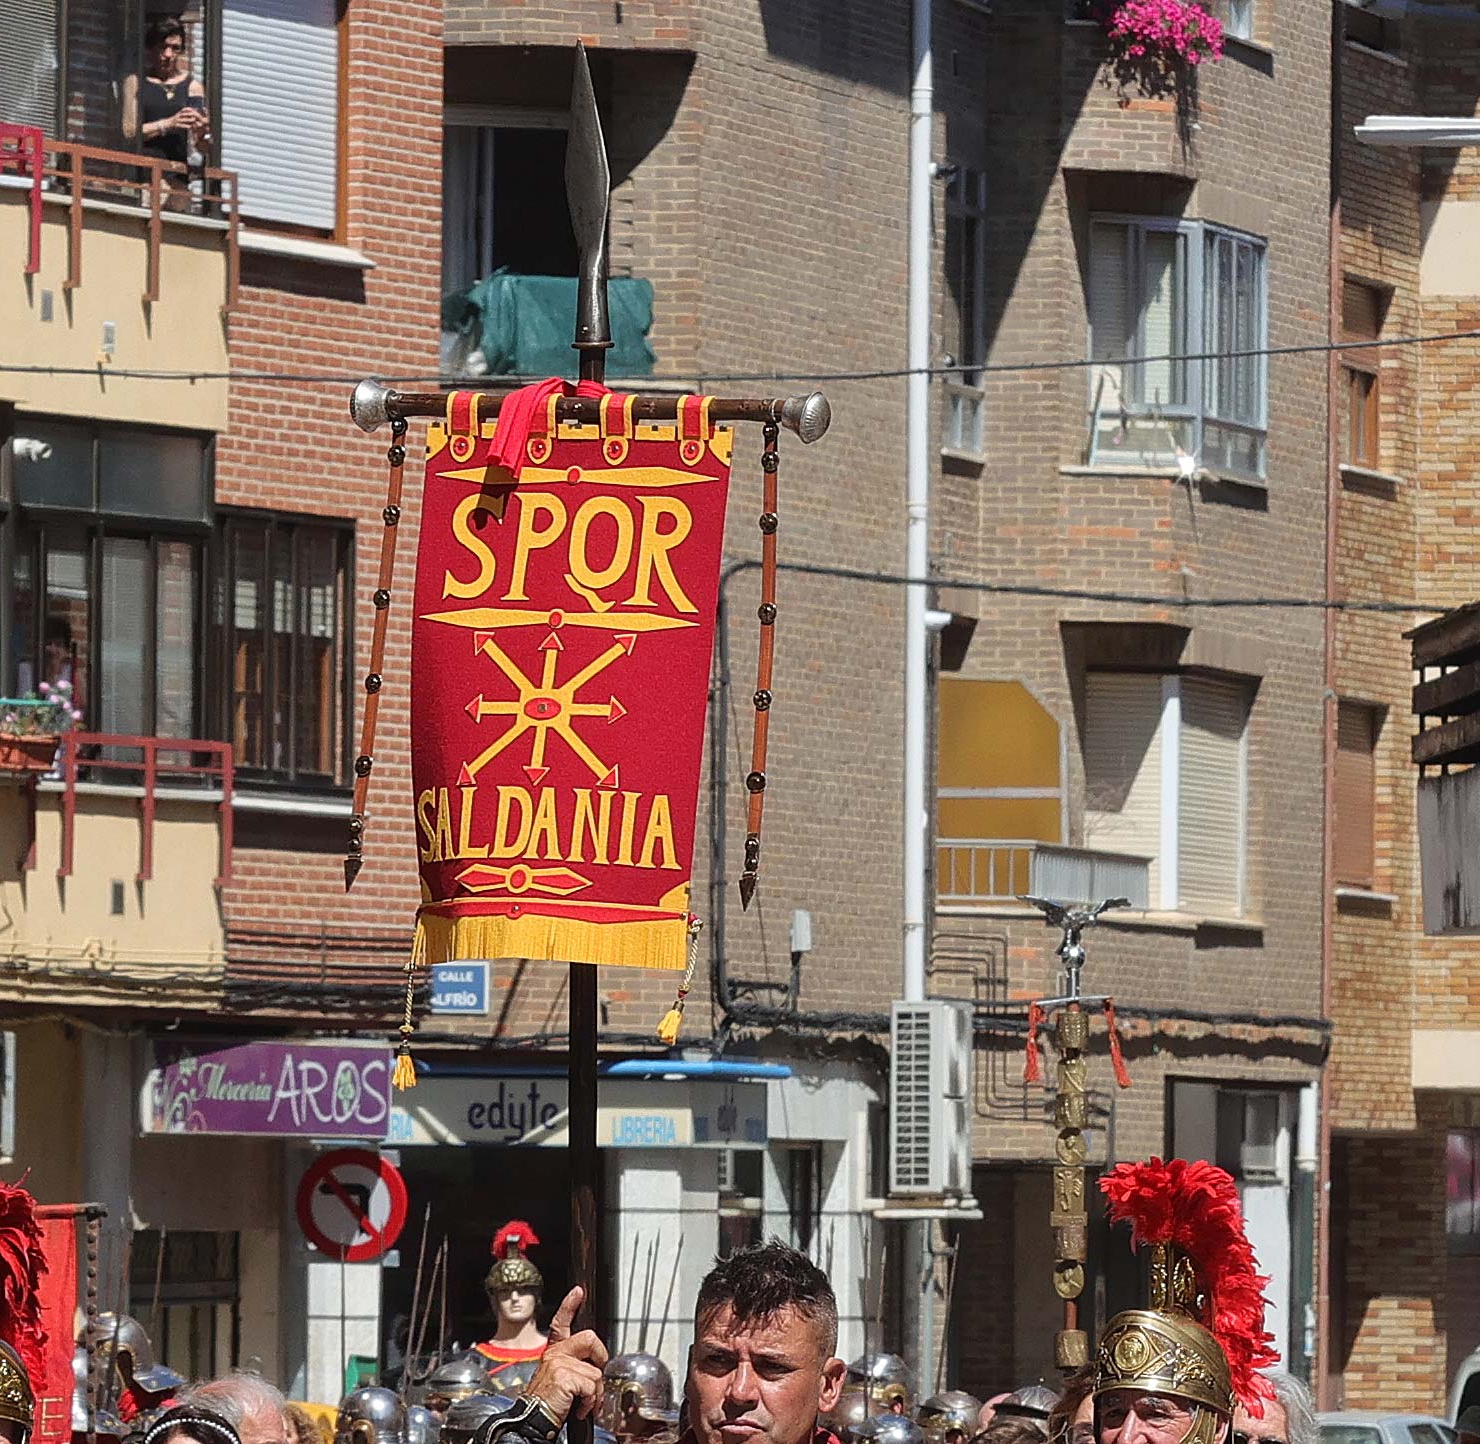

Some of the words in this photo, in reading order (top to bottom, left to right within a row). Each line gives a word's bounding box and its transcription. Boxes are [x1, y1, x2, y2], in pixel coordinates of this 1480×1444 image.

[442, 492, 700, 614] SPQR
[418, 785, 683, 871] SALDANIA
[439, 970, 474, 983] CALLE
[267, 1053, 387, 1126] AROS
